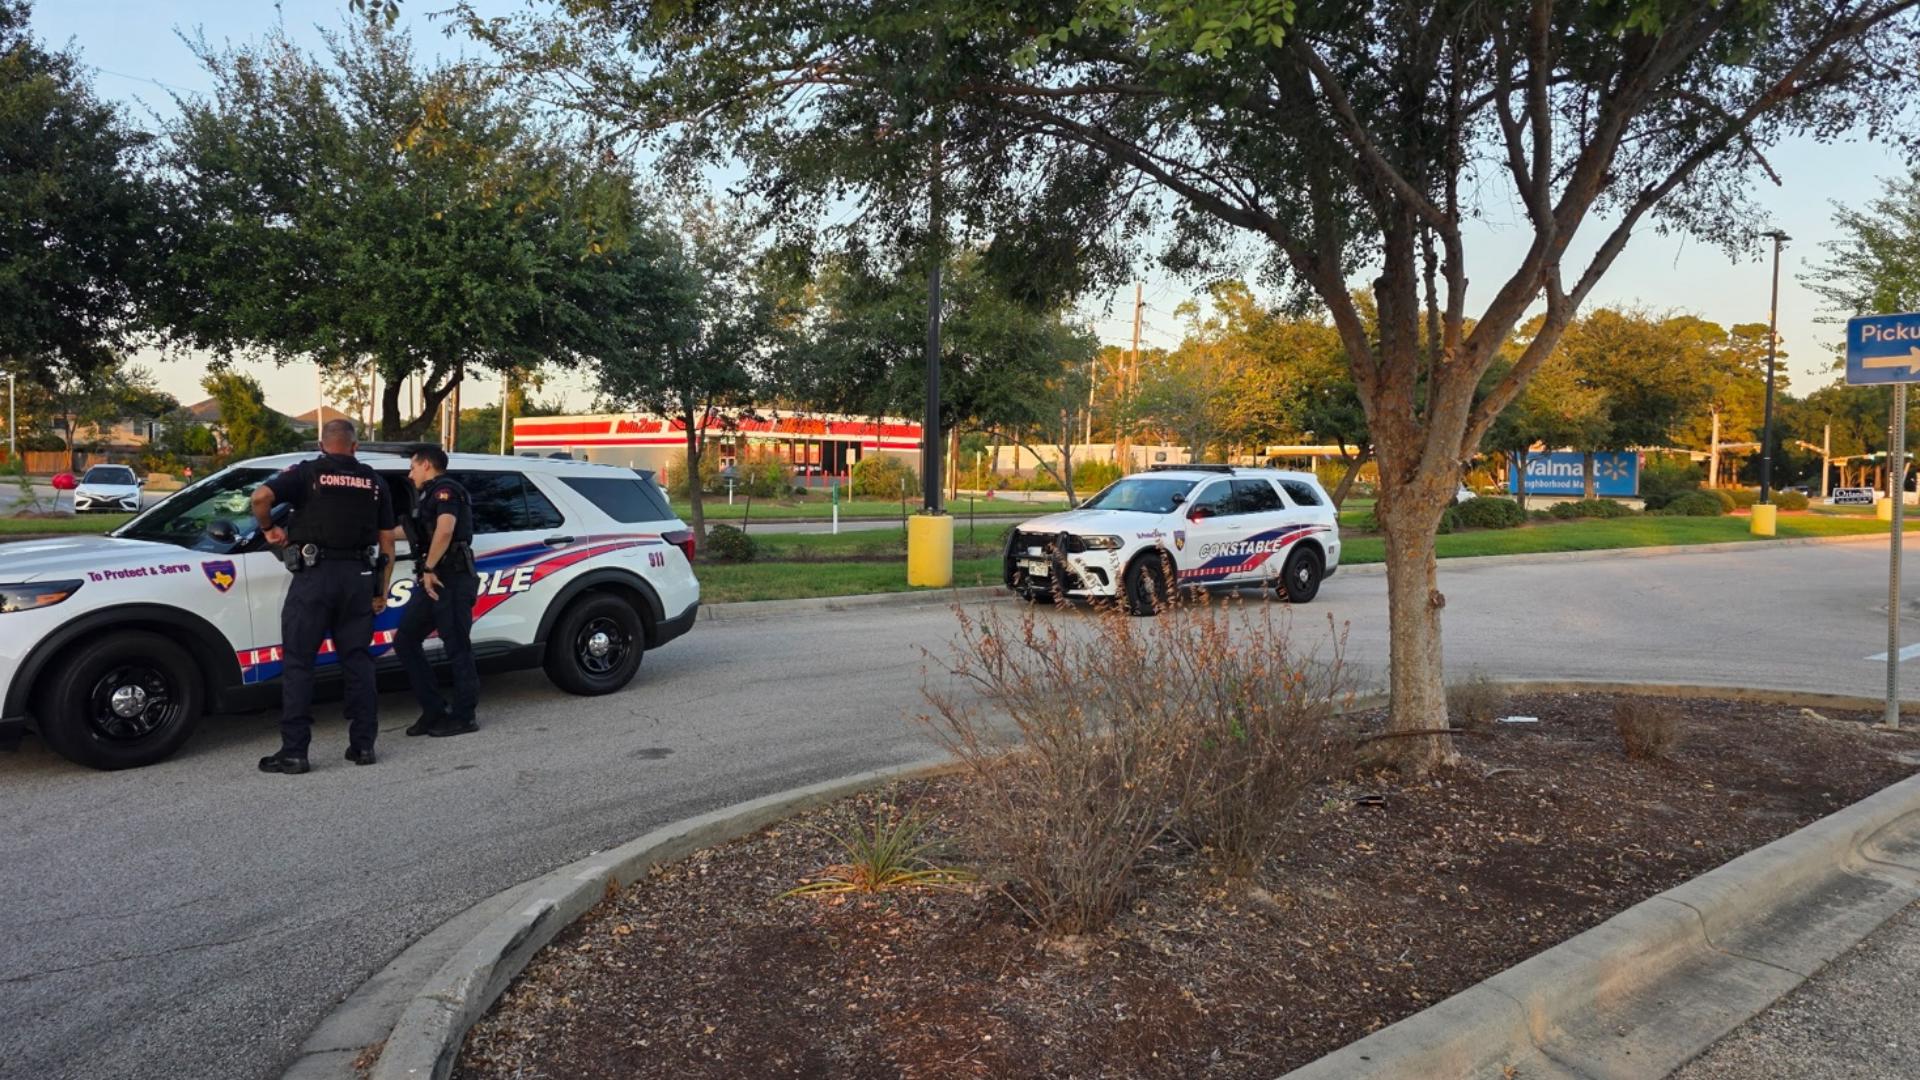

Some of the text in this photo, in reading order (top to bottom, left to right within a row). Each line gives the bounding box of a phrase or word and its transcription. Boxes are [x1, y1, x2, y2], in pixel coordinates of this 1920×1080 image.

[1861, 322, 1920, 343] Picku
[1525, 458, 1601, 477] Walmat
[319, 474, 372, 489] CONSTABLE
[1199, 538, 1282, 558] CONSTABLE
[87, 563, 192, 582] To Protect & Serve
